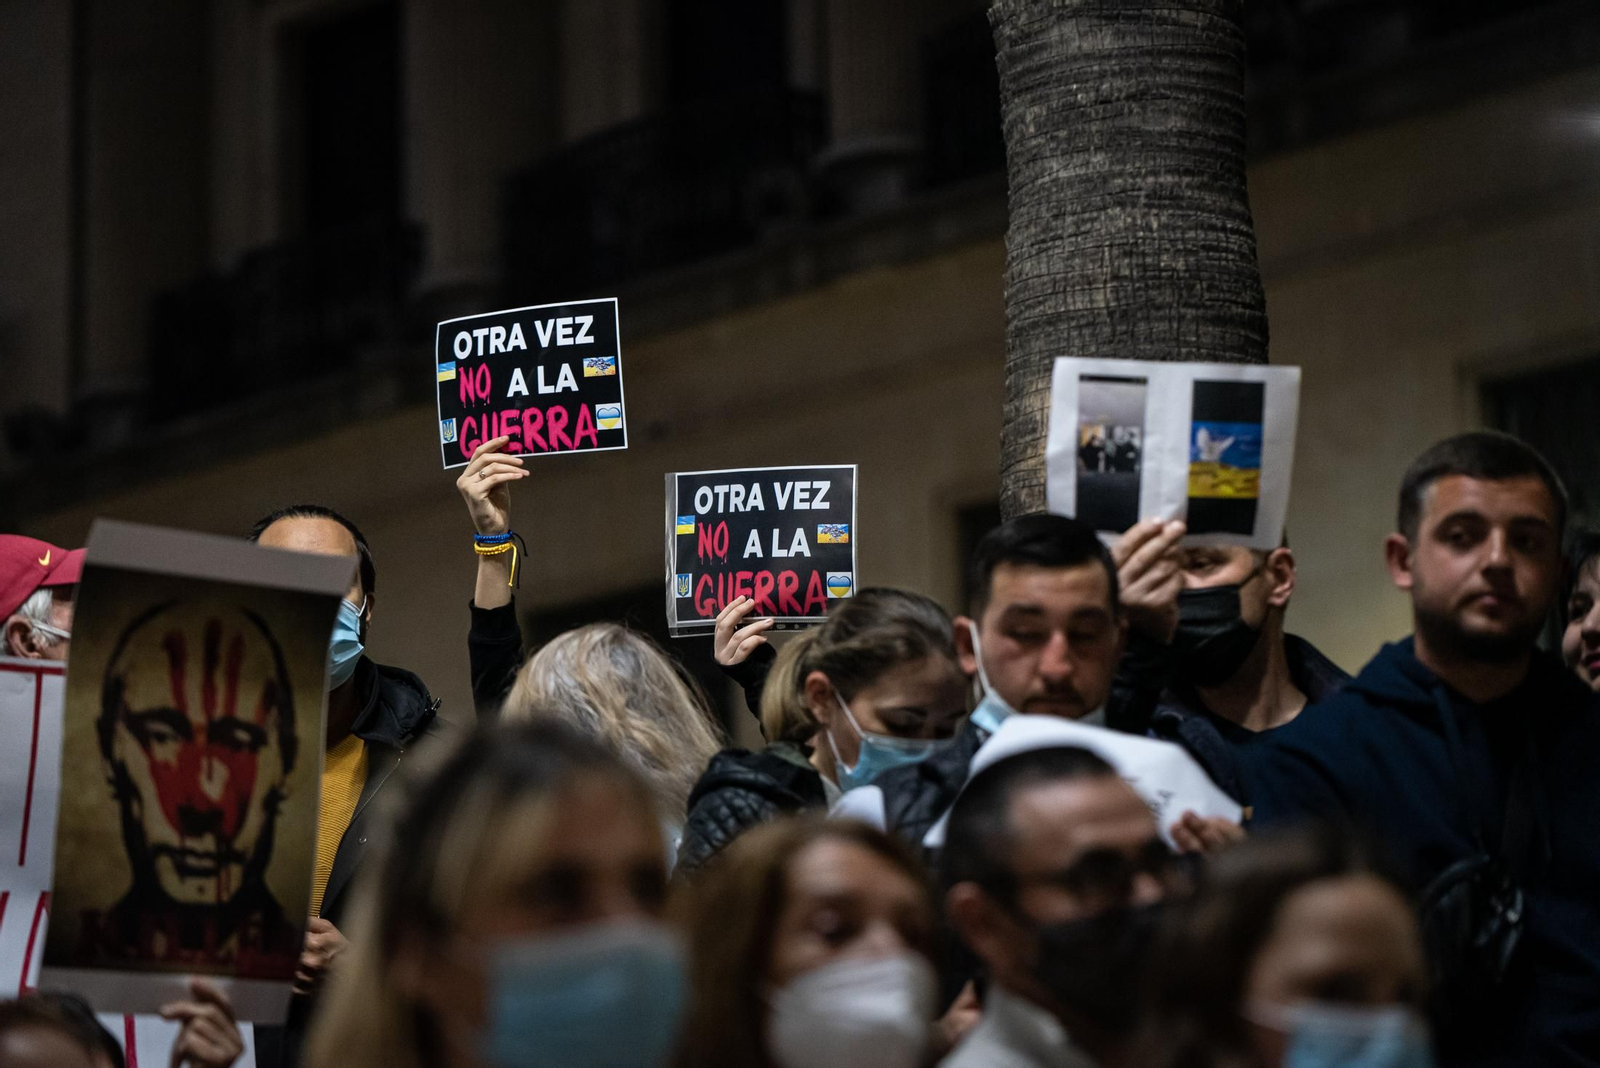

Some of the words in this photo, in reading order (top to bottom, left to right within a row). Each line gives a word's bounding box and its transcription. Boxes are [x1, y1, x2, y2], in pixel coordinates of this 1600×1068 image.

[453, 322, 527, 360] OTRA
[534, 315, 595, 348] VEZ
[458, 362, 492, 408] NO
[506, 367, 530, 398] A
[537, 363, 579, 395] LA
[694, 482, 765, 515] OTRA
[773, 480, 831, 511] VEZ
[697, 520, 730, 565] NO
[742, 529, 763, 559] A
[771, 527, 811, 558] LA
